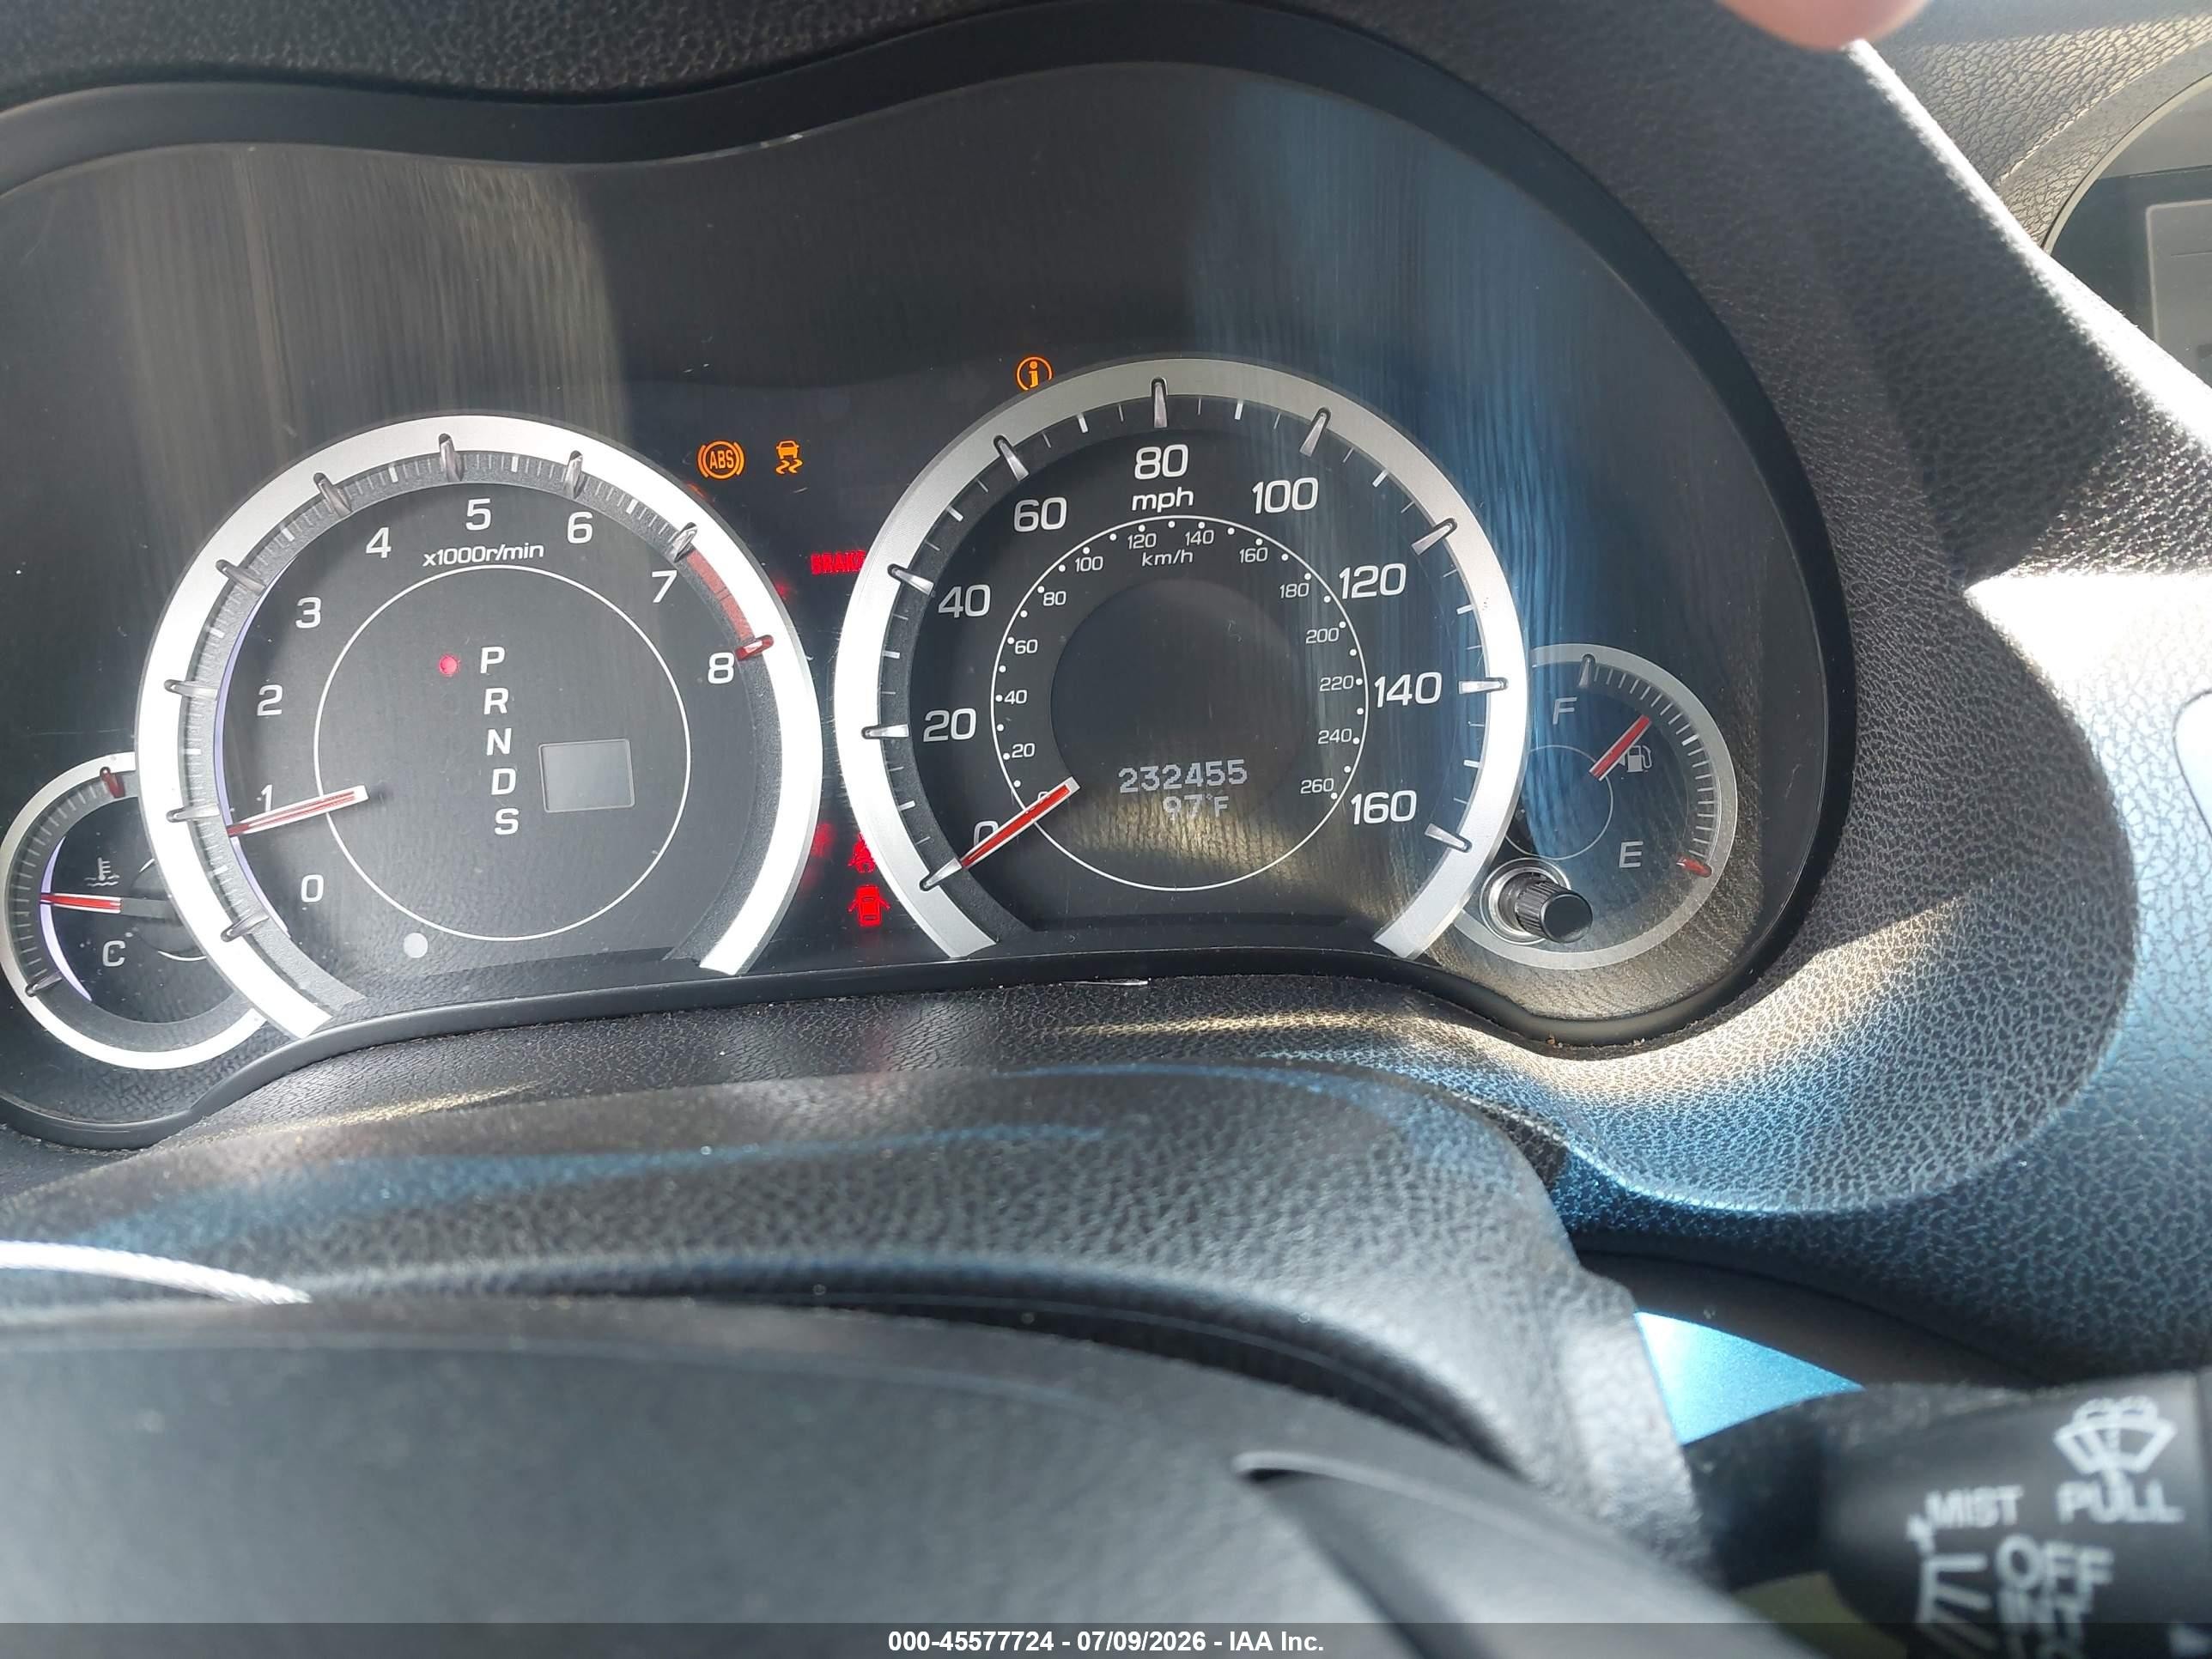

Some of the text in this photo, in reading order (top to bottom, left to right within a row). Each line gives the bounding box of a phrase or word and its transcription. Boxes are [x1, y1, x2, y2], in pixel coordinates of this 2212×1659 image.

[709, 449, 735, 470] ABS
[1134, 444, 1188, 480] 80
[1132, 486, 1194, 513] mph
[1252, 477, 1319, 514] 100
[466, 498, 491, 531] 5
[567, 512, 593, 544] 6
[1013, 496, 1067, 532] 60
[366, 527, 392, 559] 4
[1127, 533, 1157, 550] 120
[1185, 530, 1215, 546] 140
[422, 543, 544, 566] x1000r/min
[1075, 556, 1103, 573] 100
[1141, 550, 1194, 567] km/h
[1239, 547, 1268, 564] 160
[651, 570, 678, 604] 7
[1279, 582, 1310, 599] 180
[1339, 563, 1407, 599] 120
[938, 584, 991, 618] 40
[1042, 591, 1067, 606] 80
[295, 597, 322, 629] 3
[1014, 640, 1038, 654] 60
[1305, 627, 1340, 643] 200
[480, 646, 506, 674] P
[708, 652, 735, 684] 8
[1004, 690, 1028, 705] 40
[1319, 676, 1353, 691] 220
[1374, 672, 1443, 708] 140
[257, 684, 283, 716] 2
[483, 687, 509, 714] R
[1553, 696, 1577, 725] F
[923, 708, 977, 743] 20
[1317, 729, 1352, 744] 240
[487, 727, 513, 755] N
[1012, 743, 1036, 758] 20
[491, 768, 517, 795] D
[1118, 759, 1248, 793] 232455
[1300, 778, 1334, 793] 260
[494, 808, 520, 835] S
[1351, 790, 1418, 825] 160
[1619, 842, 1644, 868] E
[301, 874, 324, 902] 0
[102, 940, 126, 967] C
[1925, 1484, 2024, 1529] MIST
[2056, 1479, 2185, 1524] PULL
[1995, 1534, 2114, 1601] OFF
